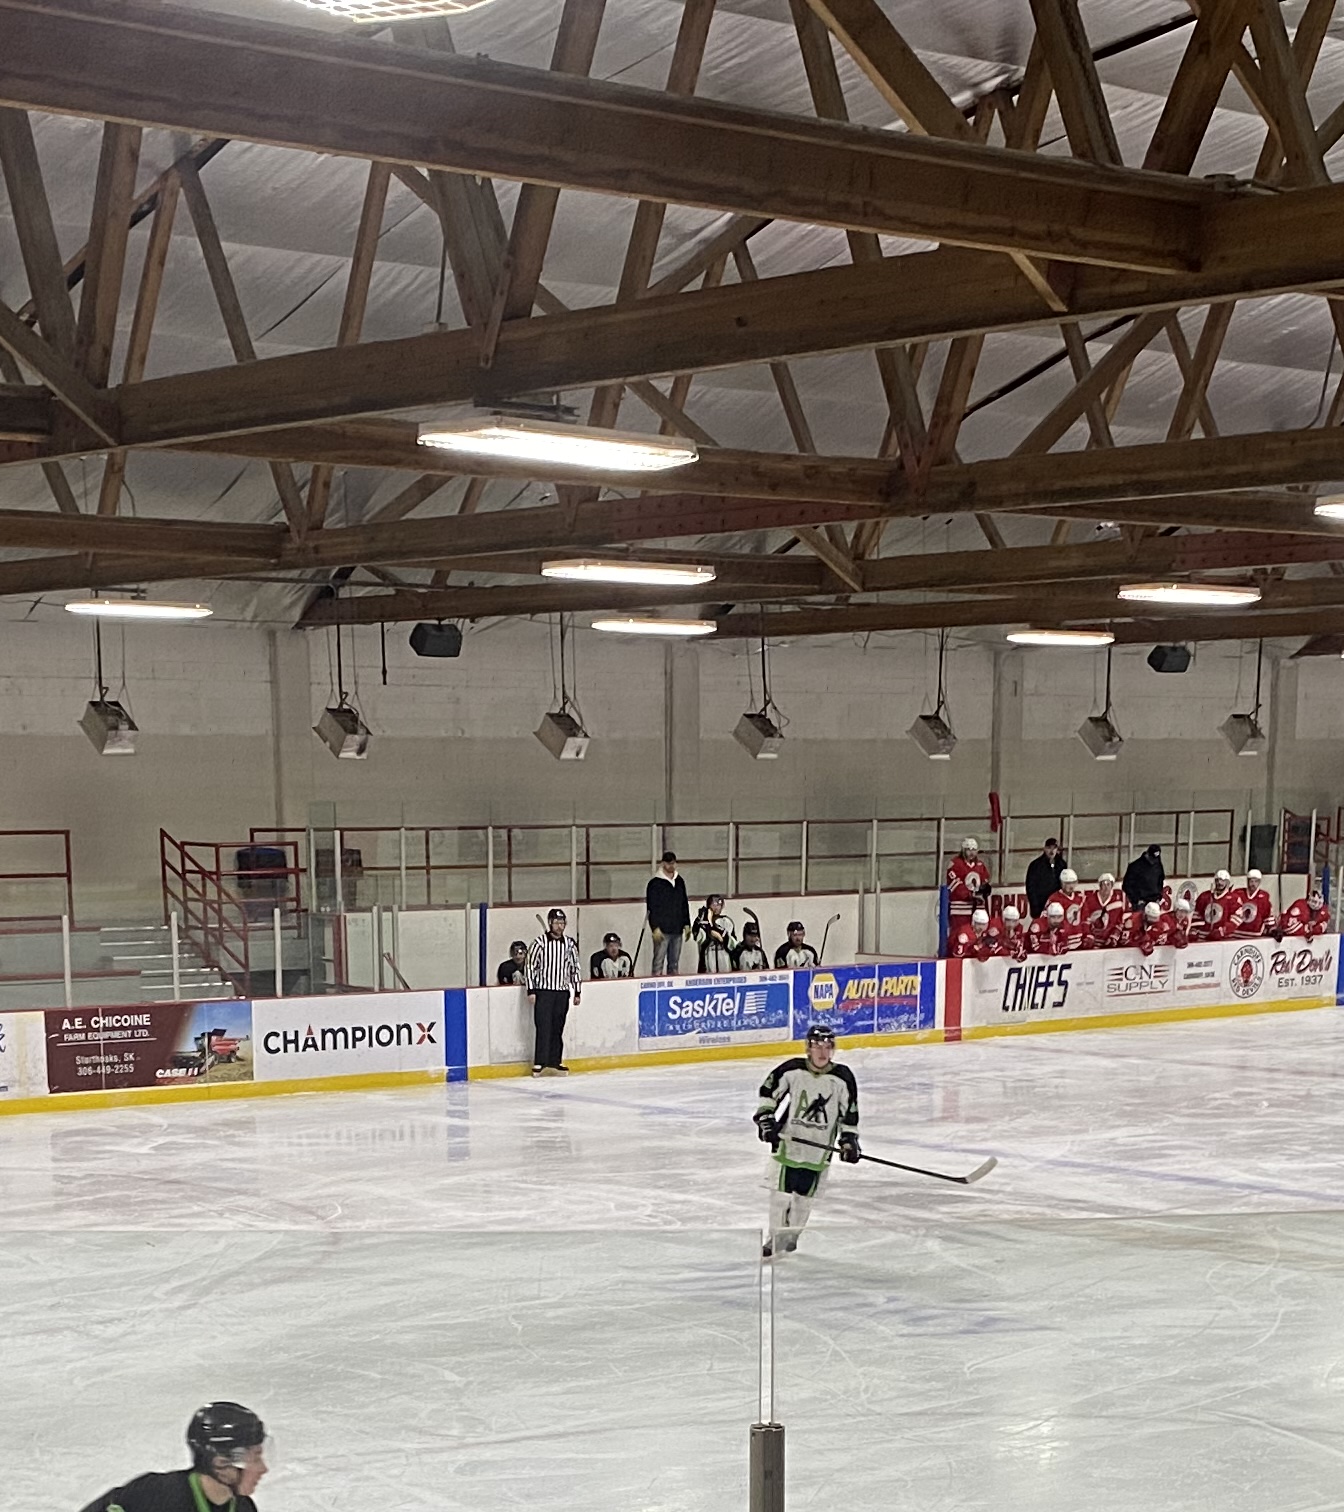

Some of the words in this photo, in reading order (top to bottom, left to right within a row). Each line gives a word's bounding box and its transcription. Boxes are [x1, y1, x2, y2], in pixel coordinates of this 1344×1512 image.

[842, 978, 878, 1000] AUTO
[880, 975, 921, 997] PARTS
[1002, 963, 1073, 1012] CHIEFS
[1106, 979, 1169, 993] SUPPLY
[1301, 974, 1323, 986] 1937
[813, 984, 834, 999] NAPA
[667, 991, 741, 1020] SaskTel
[61, 1018, 87, 1030] A.E.
[90, 1014, 152, 1029] CHICOINE
[63, 1032, 86, 1041] FARM
[155, 1068, 186, 1079] CASE
